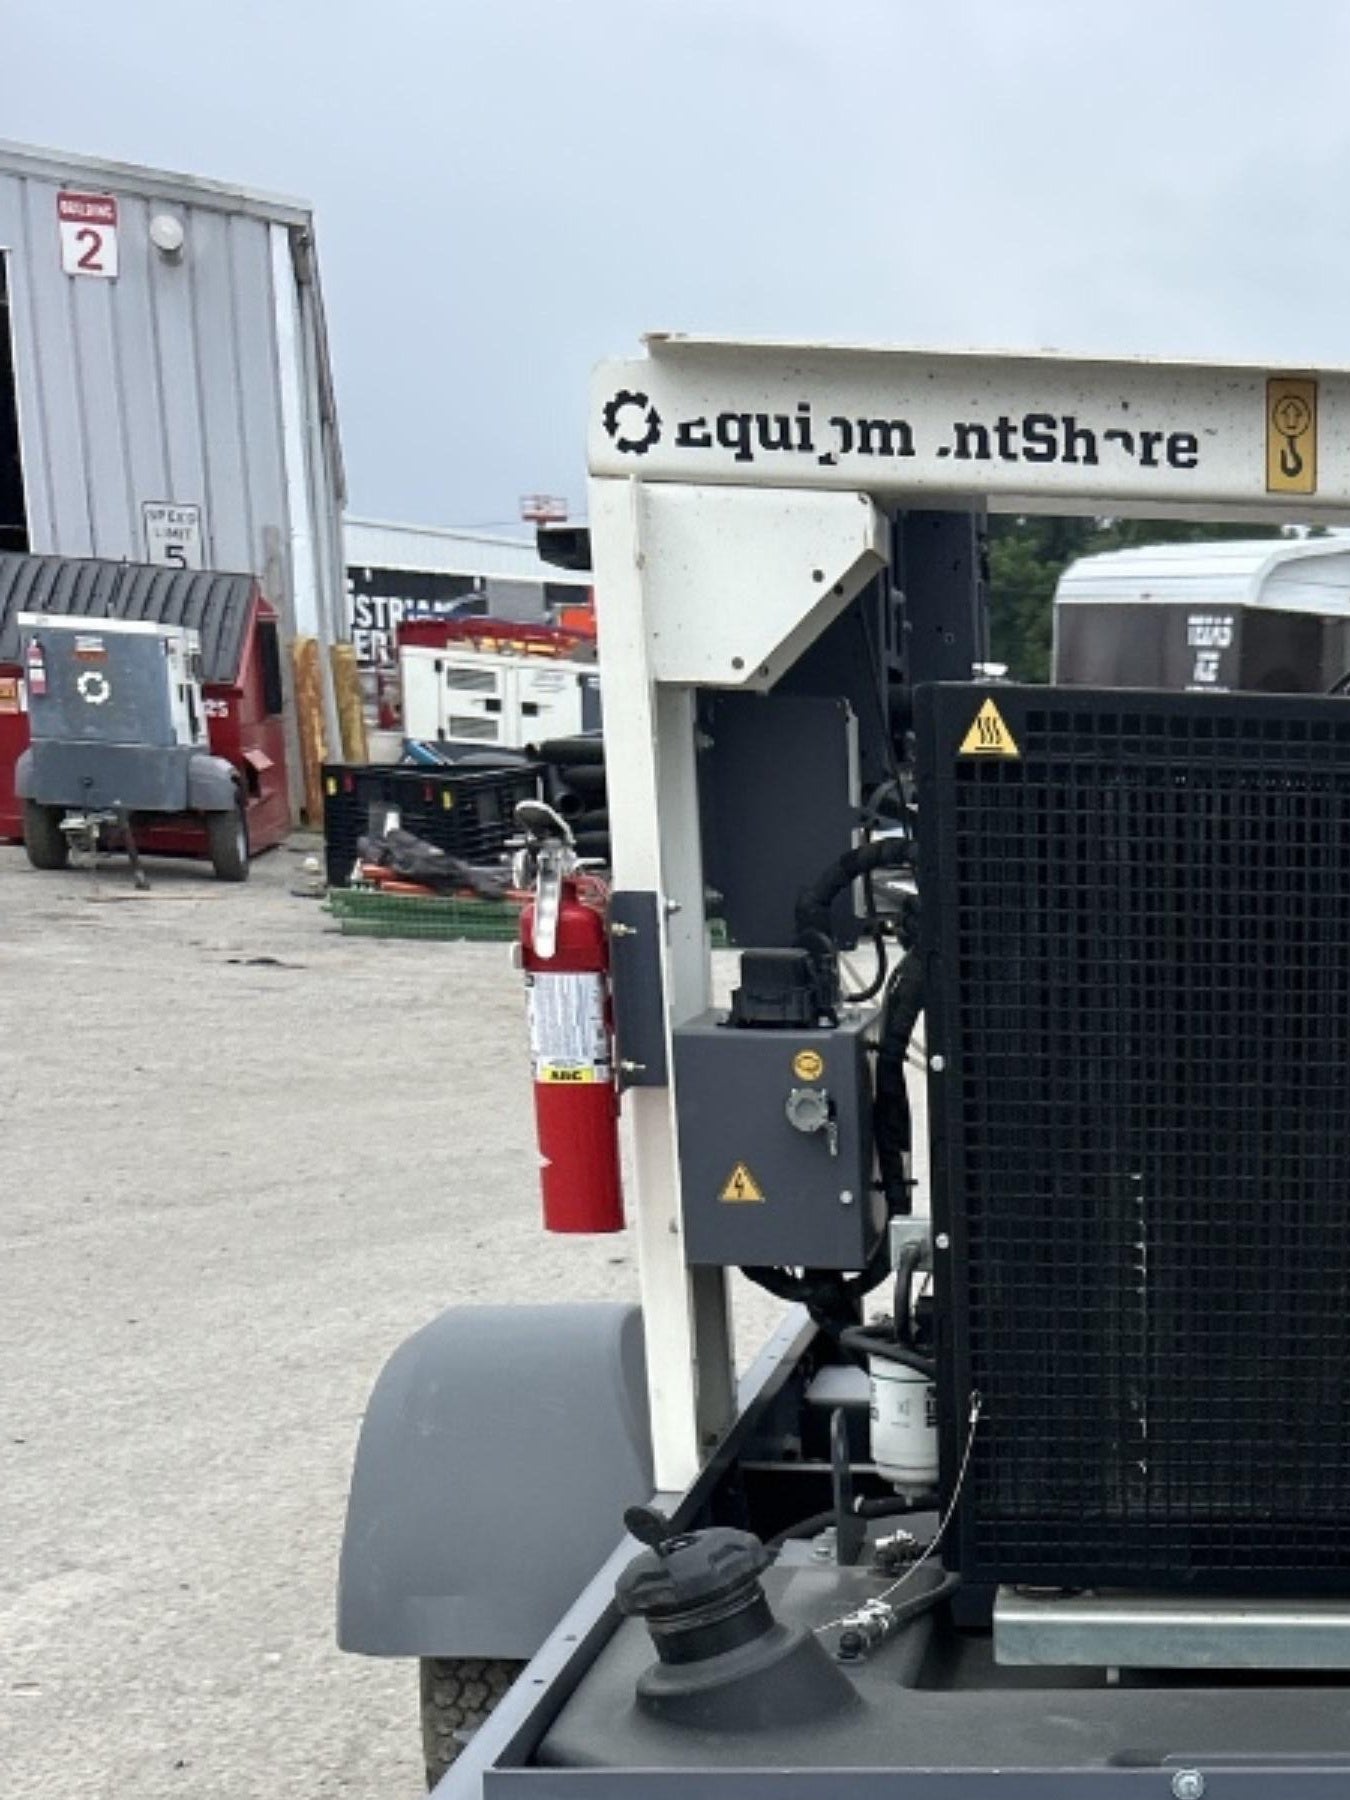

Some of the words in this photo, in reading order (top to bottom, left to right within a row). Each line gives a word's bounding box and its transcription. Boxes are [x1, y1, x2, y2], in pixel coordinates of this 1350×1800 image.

[76, 228, 103, 270] 2
[146, 508, 197, 526] SPEED
[154, 527, 192, 541] LIMIT
[164, 545, 187, 570] 5
